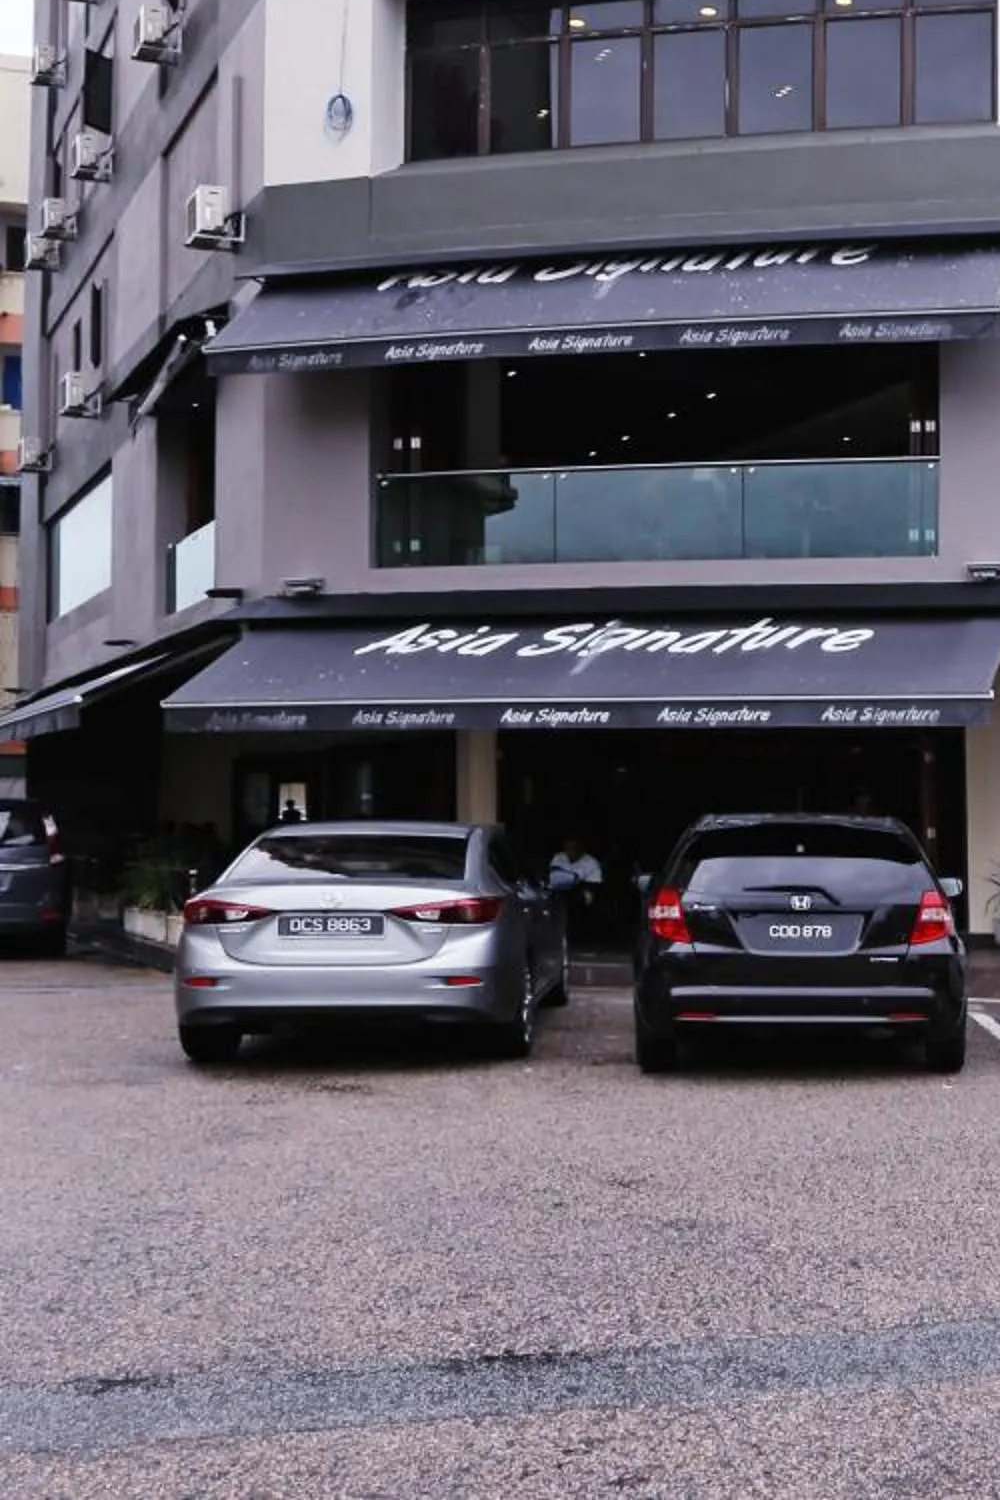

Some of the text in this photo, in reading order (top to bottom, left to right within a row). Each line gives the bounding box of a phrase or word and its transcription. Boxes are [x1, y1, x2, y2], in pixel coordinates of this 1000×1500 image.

[528, 332, 635, 352] Asia Signature
[679, 325, 790, 346] Asia Signature
[384, 341, 486, 360] Asia Signature
[354, 617, 876, 657] Asia Signature
[351, 710, 384, 726] Asia
[500, 706, 611, 728] Asia Signature
[656, 705, 772, 727] Asia Signature
[820, 704, 941, 726] Asia Signature
[327, 918, 371, 931] 8863
[802, 925, 832, 938] 878
